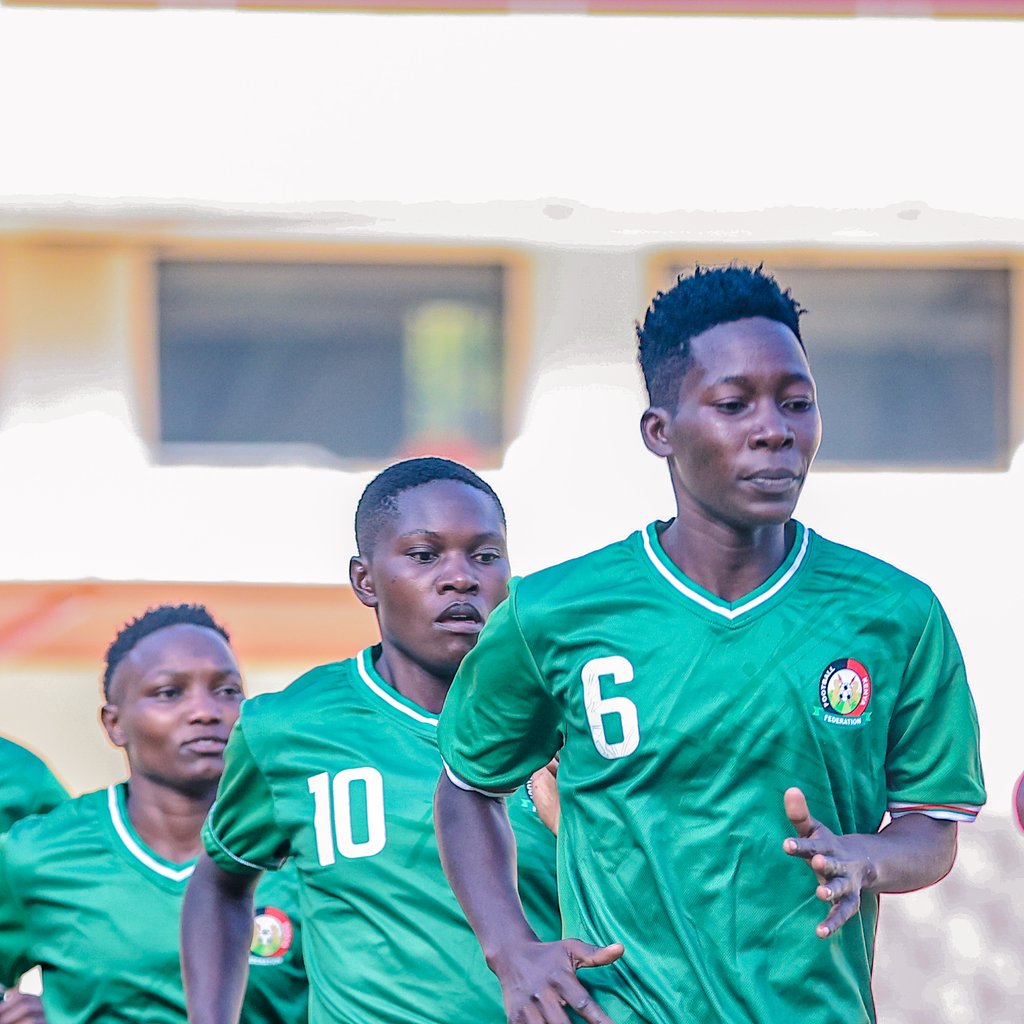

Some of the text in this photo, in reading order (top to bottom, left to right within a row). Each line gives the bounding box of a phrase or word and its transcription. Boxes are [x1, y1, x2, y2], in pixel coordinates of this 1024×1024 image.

[581, 655, 640, 760] 6
[820, 665, 836, 708] FOOTBALL
[823, 713, 862, 726] FEDERATION
[307, 766, 387, 867] 10
